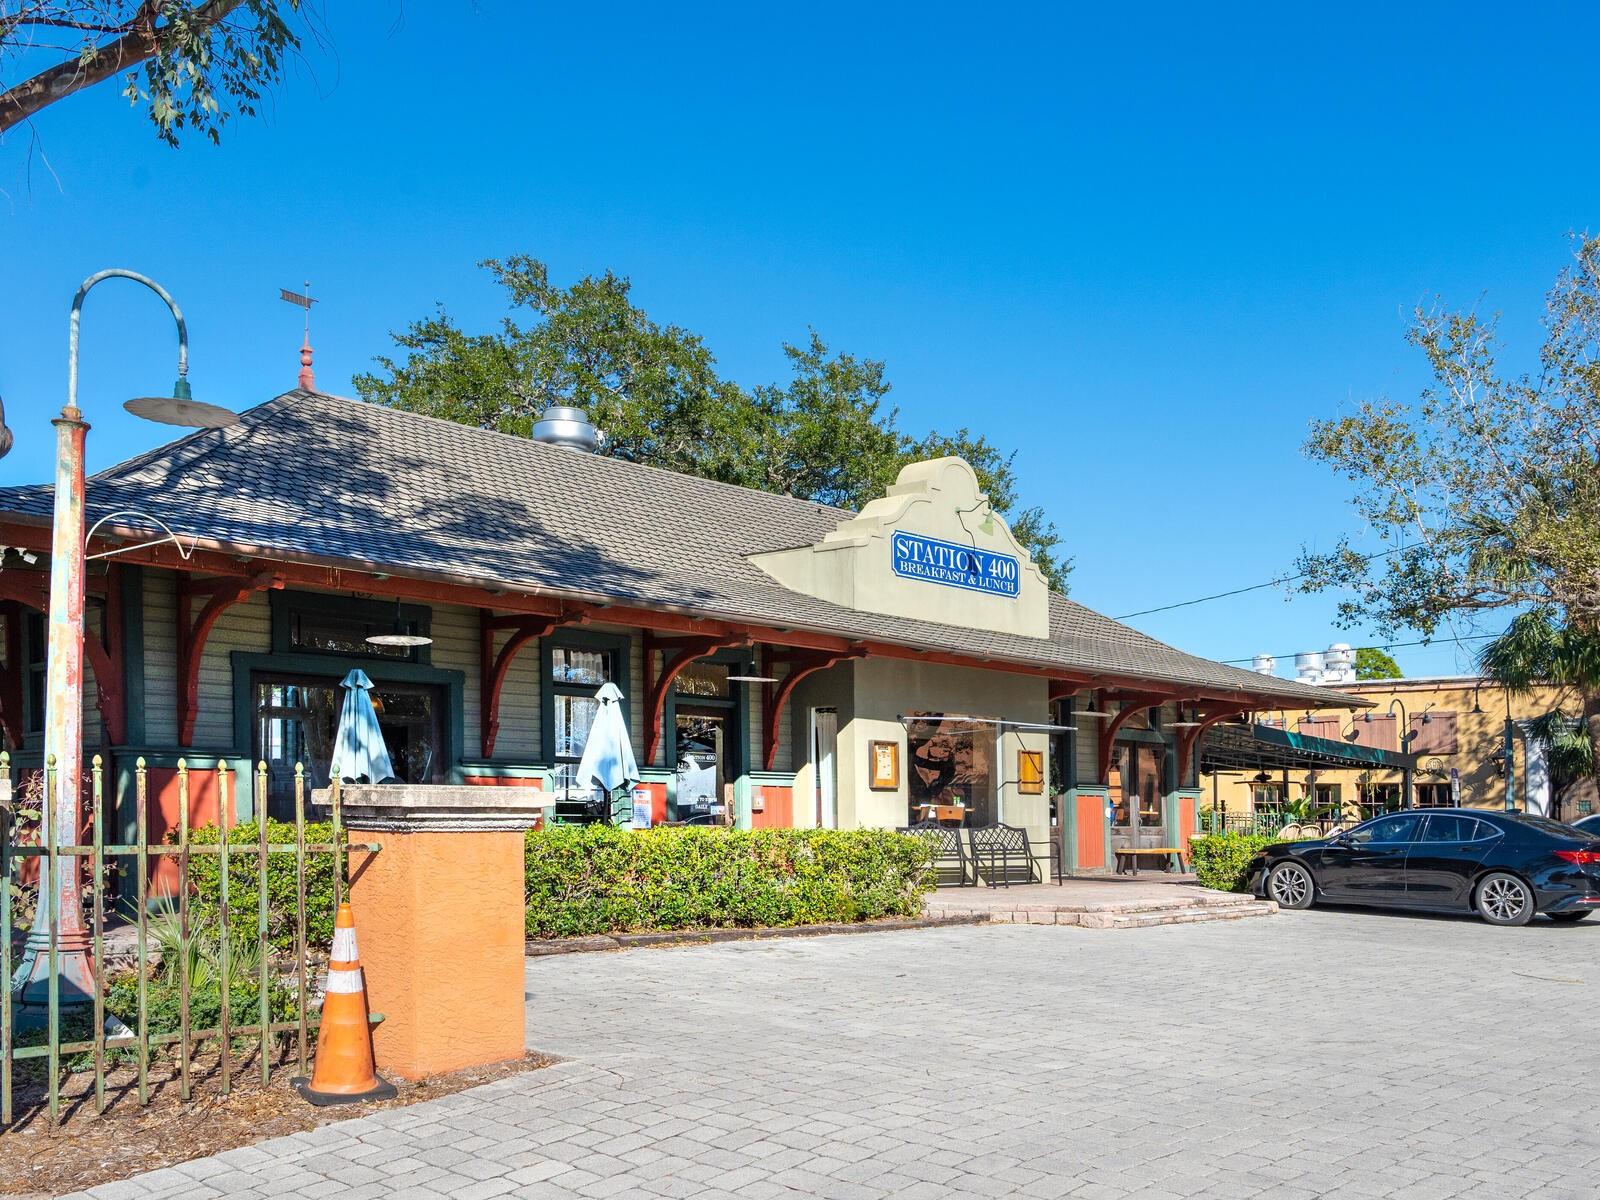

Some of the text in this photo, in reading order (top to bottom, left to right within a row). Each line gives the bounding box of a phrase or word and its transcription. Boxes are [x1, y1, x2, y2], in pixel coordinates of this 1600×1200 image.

[896, 537, 1016, 580] STATION 400
[900, 561, 1015, 592] BREAKFAST & LUNCH
